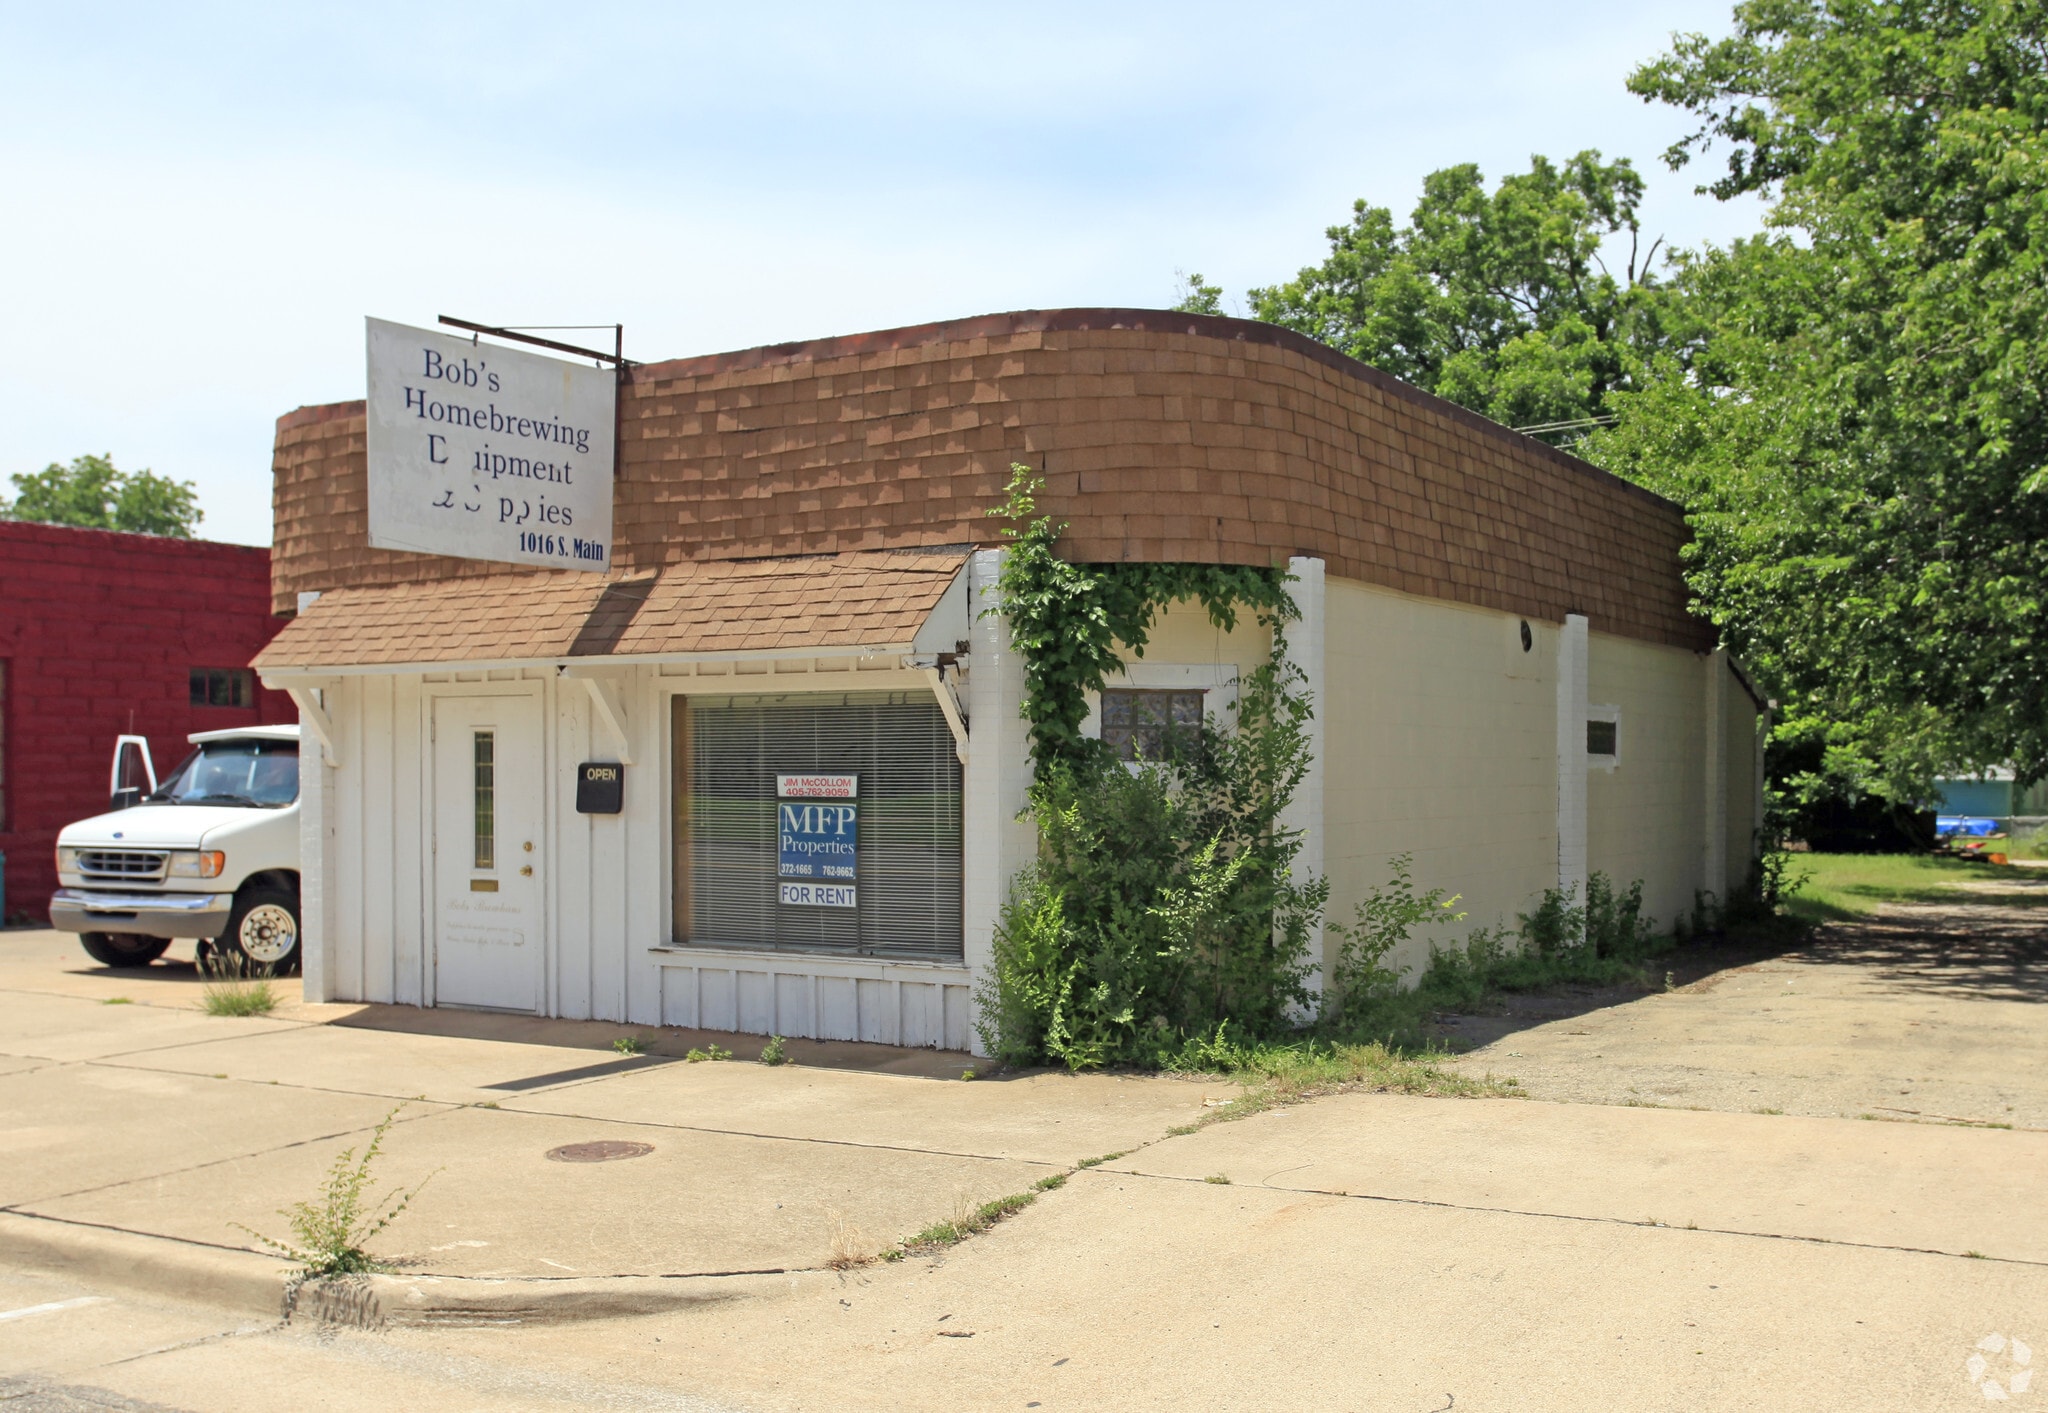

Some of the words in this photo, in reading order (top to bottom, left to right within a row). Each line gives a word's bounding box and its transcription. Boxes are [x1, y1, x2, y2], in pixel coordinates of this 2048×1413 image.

[422, 348, 500, 392] Bob's
[404, 386, 590, 453] Homebrewing
[427, 433, 573, 485] Eipment
[520, 531, 554, 555] 1016
[558, 535, 568, 557] S.
[573, 538, 603, 561] Main
[587, 768, 616, 781] OPEN
[784, 778, 798, 787] JIM
[801, 778, 851, 787] McCOLLOM
[786, 788, 849, 797] 405-762-9059
[782, 805, 856, 835] MFP
[782, 835, 854, 856] Properties
[782, 886, 811, 903] FOR
[815, 887, 854, 905] RENT
